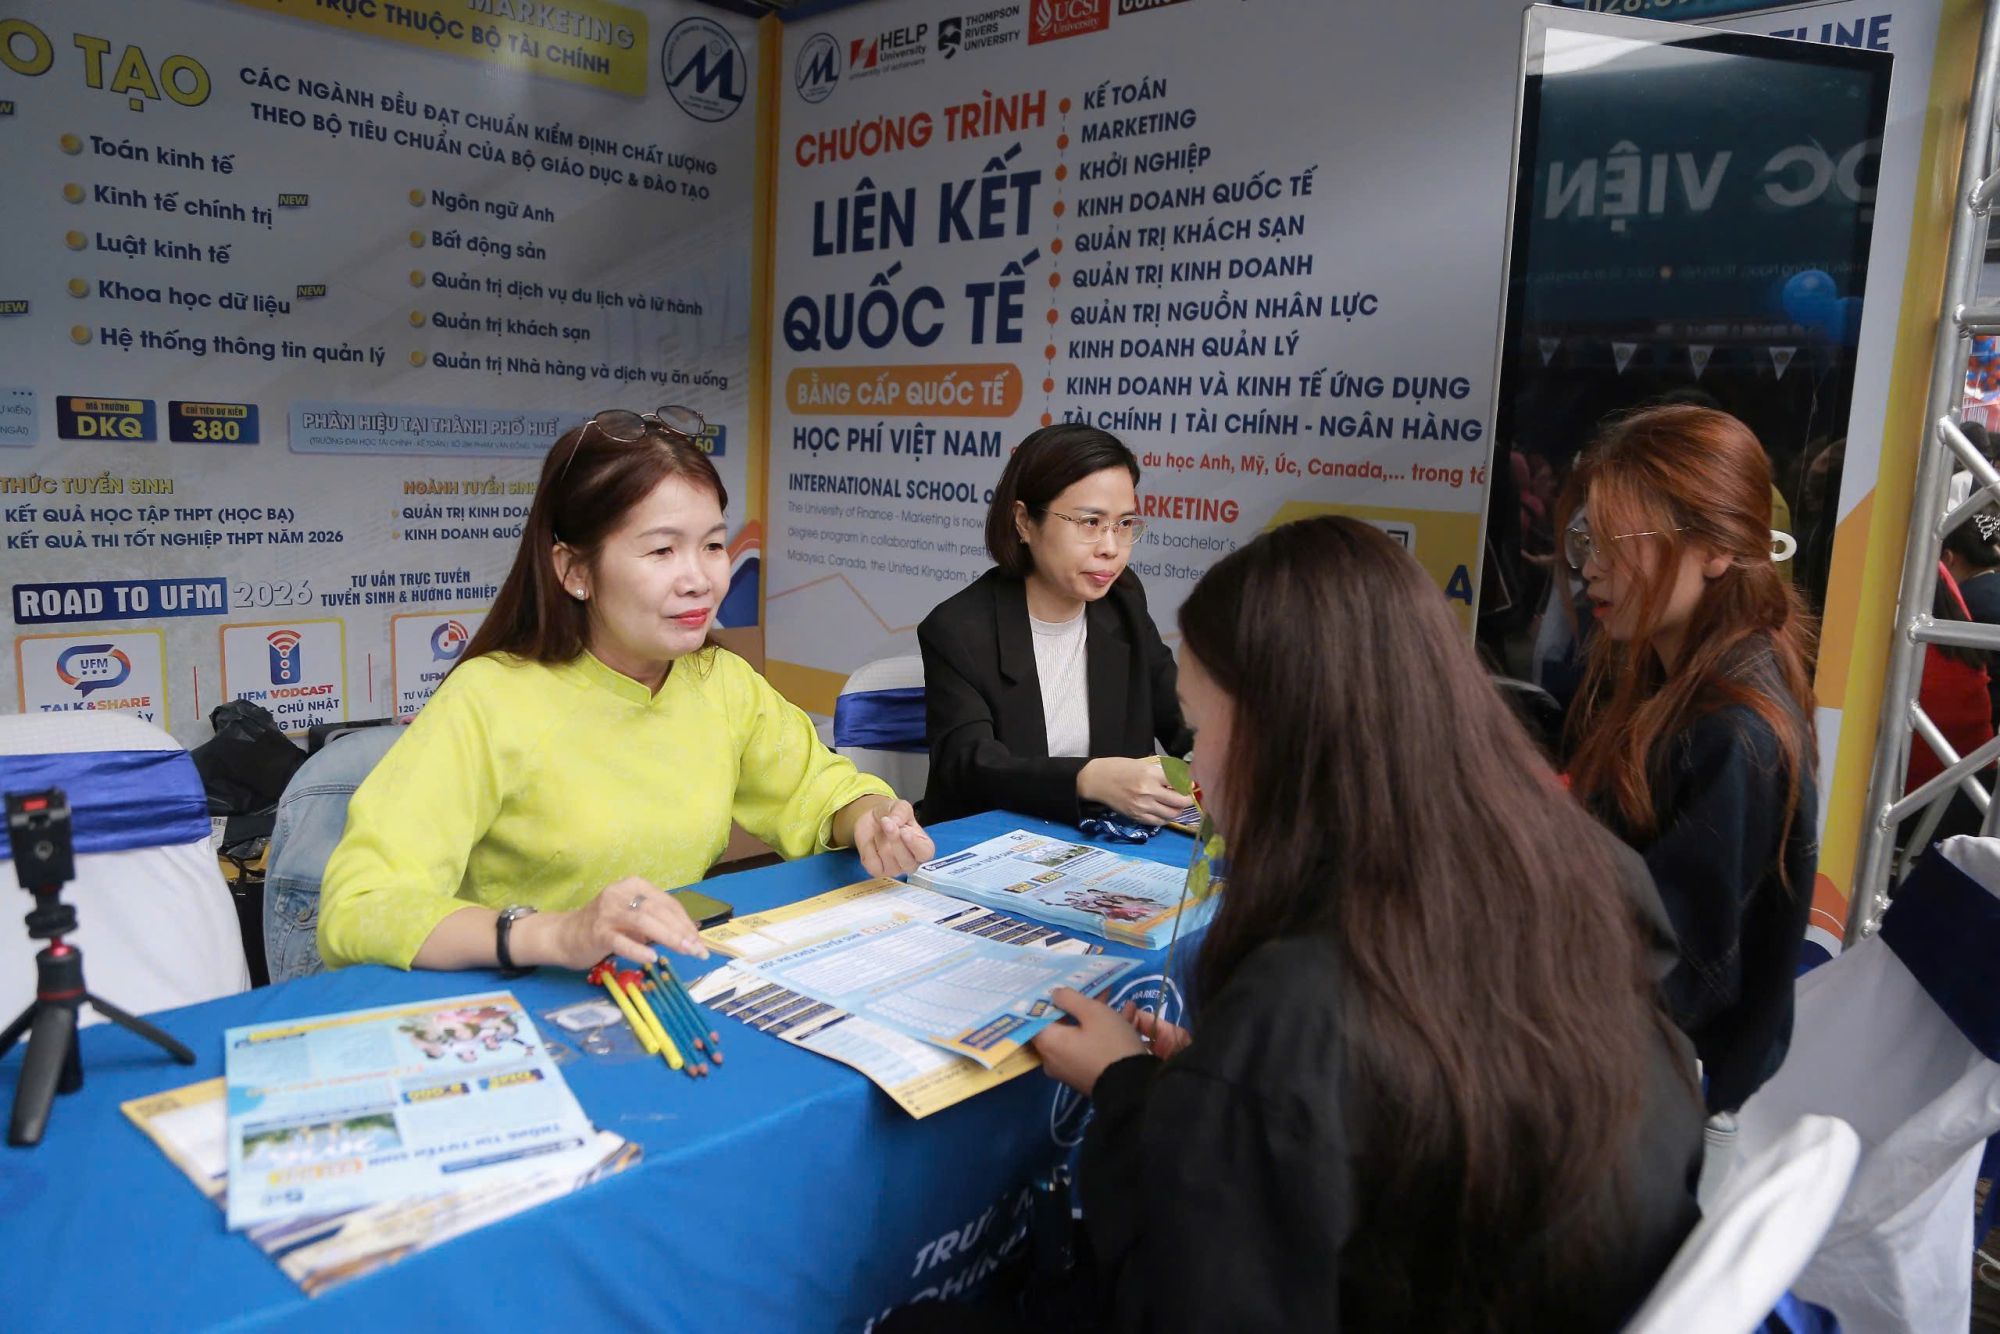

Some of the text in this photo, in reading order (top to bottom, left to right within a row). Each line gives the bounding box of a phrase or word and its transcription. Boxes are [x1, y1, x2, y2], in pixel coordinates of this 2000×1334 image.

[965, 23, 998, 39] RIVERS
[966, 6, 1020, 26] THOMPSON
[1054, 18, 1099, 33] University
[881, 24, 928, 50] HELP
[964, 30, 1021, 51] UNIVERSITY
[880, 46, 926, 62] University
[73, 33, 212, 112] TẠO
[1084, 76, 1167, 110] KẾ TOÁN
[796, 90, 1046, 167] CHƯƠNG TRÌNH
[1081, 108, 1197, 143] MARKETING
[90, 135, 235, 175] Toán kinh tế
[1080, 143, 1211, 181] KHỞI NGHIỆP
[94, 184, 272, 230] Kinh tế chính trị
[279, 195, 308, 206] NEW
[432, 190, 554, 223] Ngôn ngữ Anh
[813, 142, 1041, 256] LIÊN KẾT
[1077, 164, 1318, 218] KINH DOANH QUỐC TẾ
[96, 233, 231, 264] Luật kinh tế
[432, 229, 546, 260] Bất động sản
[1075, 215, 1305, 252] QUẢN TRỊ KHÁCH SẠN
[1073, 254, 1313, 289] QUẢN TRỊ KINH DOANH
[99, 280, 291, 318] Khoa học dữ liệu
[297, 285, 325, 297] NEW
[783, 248, 1040, 351] QUỐC TẾ
[1070, 290, 1379, 328] QUẢN TRỊ NGUỒN NHÂN LỰC
[432, 312, 591, 342] Quản trị khách sạn
[100, 327, 385, 366] Hệ thống thông tin quản lý
[1068, 329, 1300, 359] KINH DOANH QUẢN LÝ
[797, 371, 1010, 406] BẰNG CẤP QUỐC TẾ
[1066, 367, 1471, 406] KINH DOANH VÀ KINH TẾ ỨNG DỤNG
[77, 415, 144, 439] DKQ
[192, 419, 240, 441] 380
[359, 412, 398, 434] HIỆU
[401, 416, 428, 436] TẠI
[432, 415, 487, 435] THÀNH
[793, 422, 1001, 461] HỌC PHÍ VIỆT NAM
[0, 471, 174, 495] THỨC TUYỂN SINH
[1143, 452, 1161, 467] du
[1166, 453, 1195, 473] học
[1200, 454, 1235, 473] Anh,
[1241, 455, 1269, 476] Mỹ,
[1275, 453, 1301, 477] Úc,
[1412, 463, 1463, 488] trong
[789, 473, 1239, 523] INTERNATIONAL SCHOOL ARKETING
[5, 504, 295, 526] KẾT QUẢ HỌC TẬP THPT (HỌC BẠ)
[805, 504, 843, 518] University
[846, 506, 855, 517] of
[857, 507, 893, 520] Finance
[902, 511, 950, 528] Marketing
[953, 515, 960, 527] is
[962, 518, 984, 528] now
[1147, 533, 1159, 544] its
[1163, 534, 1236, 551] bachelor's
[7, 528, 344, 549] KẾT QUẢ THI TỐT NGHIỆP THPT NĂM 2026
[820, 530, 858, 545] program
[861, 531, 869, 543] in
[871, 534, 934, 551] collaboration
[938, 542, 957, 553] with
[352, 570, 471, 589] TƯ VẤN TRỰC TUYẾN
[19, 580, 313, 617] ROAD TO UFM 2026
[80, 658, 108, 669] UFM
[271, 685, 333, 699] VODCAST
